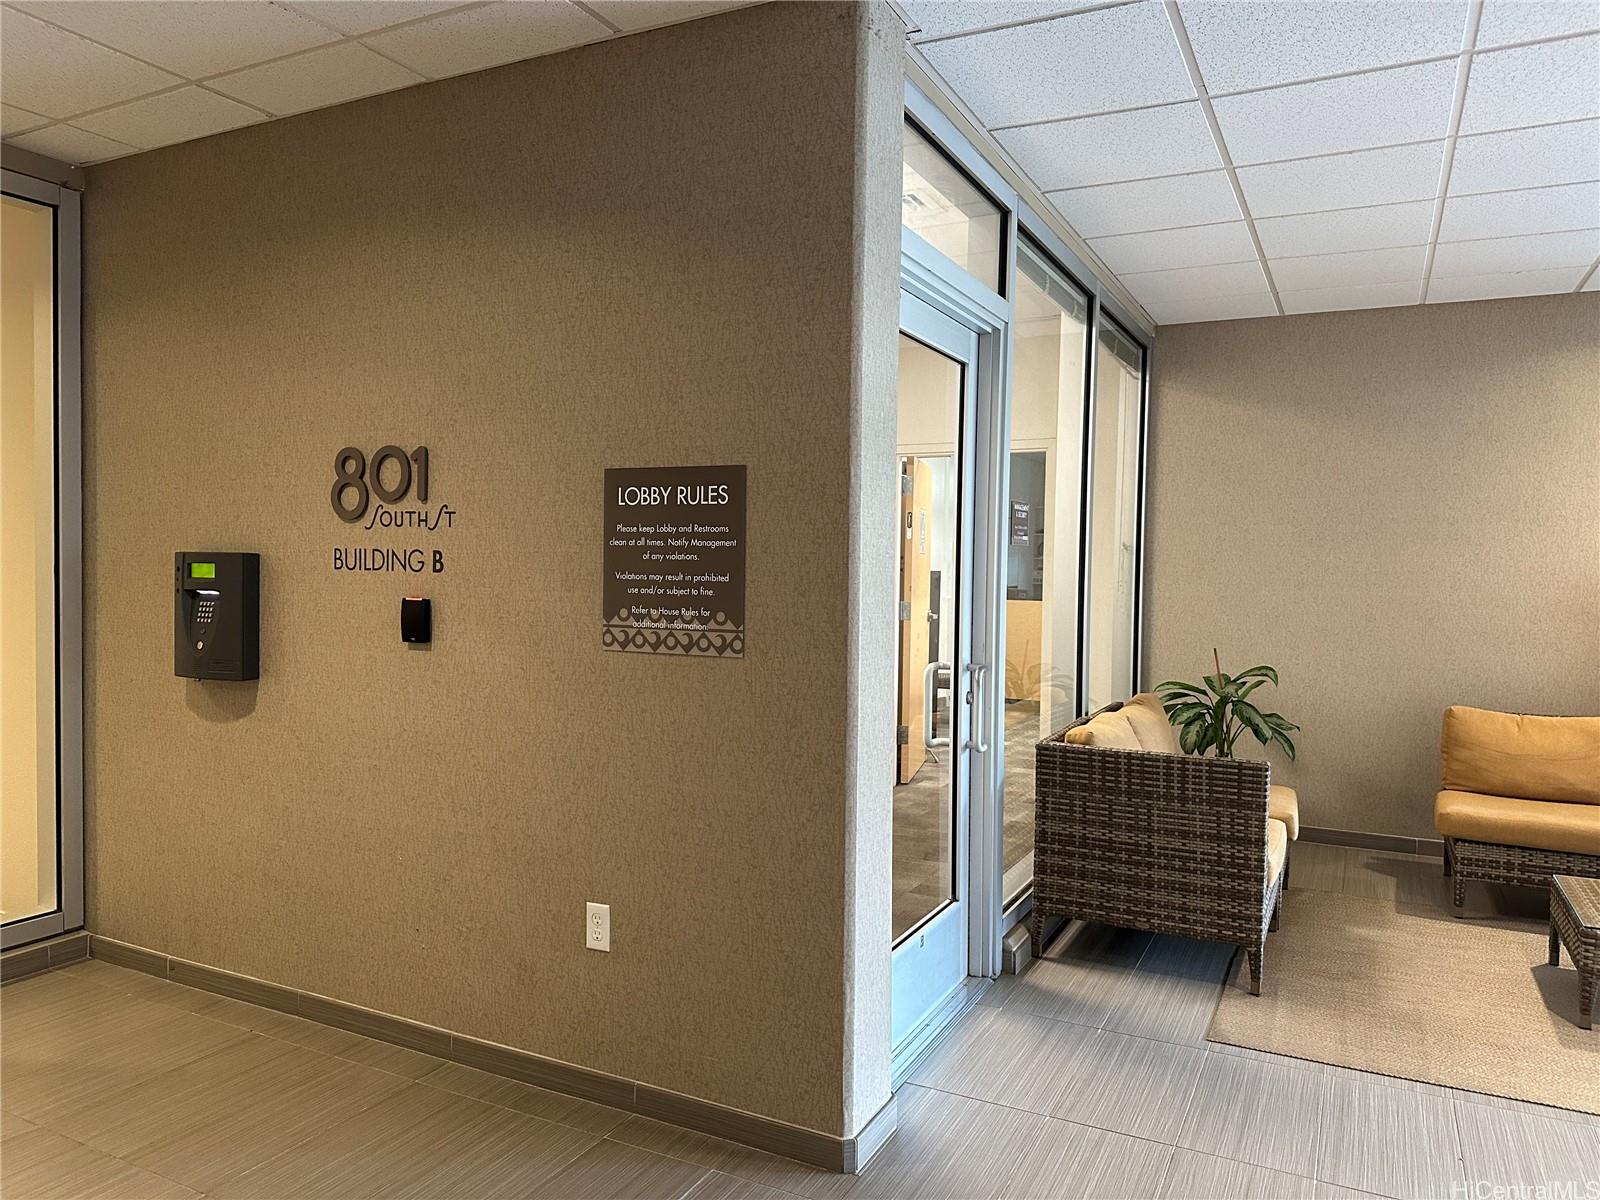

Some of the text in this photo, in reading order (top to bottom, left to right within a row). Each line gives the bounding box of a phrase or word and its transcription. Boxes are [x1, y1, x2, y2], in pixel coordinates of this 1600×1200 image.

[331, 445, 429, 523] 801
[618, 484, 729, 506] LOBBY RULES
[616, 523, 729, 534] Please keep Lobby and Restrooms
[609, 536, 737, 548] clean at all times. Notify Management
[333, 547, 445, 573] BUILDING B
[642, 551, 700, 562] of any violations.
[615, 571, 730, 583] Violations may result in prohibited
[640, 586, 664, 595] and/or
[666, 586, 690, 597] subject
[691, 587, 699, 596] to
[700, 587, 716, 596] fine.
[631, 605, 711, 617] Refer to House Rules for
[632, 620, 709, 631] additional information.
